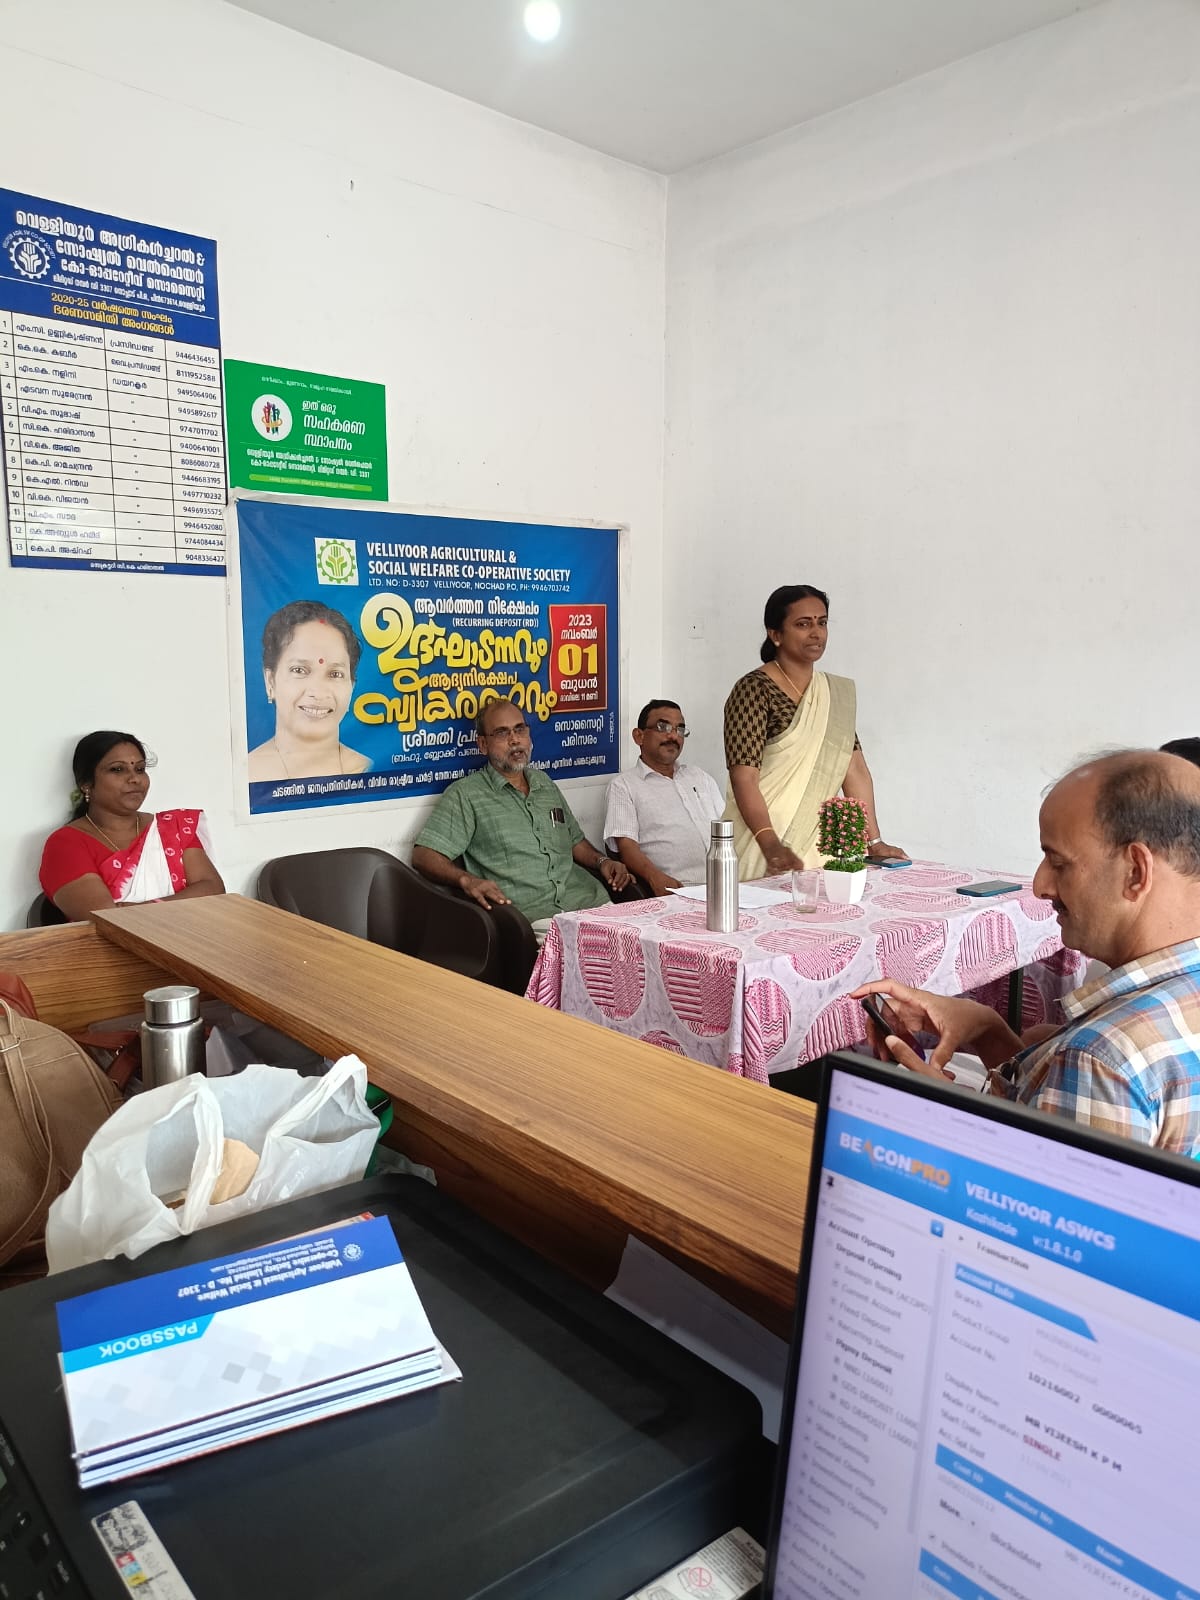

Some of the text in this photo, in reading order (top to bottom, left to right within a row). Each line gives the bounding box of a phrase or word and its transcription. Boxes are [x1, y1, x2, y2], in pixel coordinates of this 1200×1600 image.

[16, 210, 94, 242] വെള്ളിയൂർ
[55, 239, 122, 267] സോഷ്യൽ
[146, 277, 205, 302] സൊസൈറ്റി
[51, 292, 89, 307] 2020-25
[53, 304, 175, 335] ഭരണസമിതി അംഗങ്ങൾ
[3, 320, 7, 328] 1
[175, 351, 215, 364] 9446436455
[3, 340, 8, 348] 2
[178, 407, 217, 418] 9495892617
[321, 403, 336, 415] ഒരു
[303, 414, 366, 435] സഹകരണ
[9, 439, 15, 447] 7
[304, 434, 352, 451] സ്ഥാപനം
[11, 456, 16, 464] 8
[12, 473, 17, 481] 9
[12, 490, 20, 498] 10
[14, 508, 20, 516] 11
[14, 526, 22, 534] 12
[16, 543, 23, 551] 13
[366, 542, 517, 564] VELLIYOOR AGRICULTURAL &
[368, 560, 571, 582] SOCIAL WELFARE CO-OPERATIVE SOCIETY
[369, 578, 383, 586] LTD.
[386, 579, 400, 587] NO:
[402, 579, 429, 588] D-3307
[434, 580, 473, 590] VELLIYOOR,
[475, 582, 505, 590] NOCHAD
[531, 584, 570, 592] 9946703742
[415, 596, 539, 617] ആവർത്തന നിക്ഷേപം
[452, 618, 539, 628] (RECURRING DEPOSIT (RD))
[568, 614, 592, 627] 2023
[360, 592, 548, 674] ഉദ്ഘാടനവും
[560, 627, 598, 640] നവംബർ
[558, 643, 598, 676] 01
[429, 667, 518, 691] ആദ്യനിക്ഷേപ
[560, 676, 598, 693] ബുധൻ
[554, 715, 604, 735] സൊസൈറ്റി
[402, 727, 454, 752] ശ്രീമതി
[561, 732, 598, 747] പരിസരം
[272, 784, 305, 798] ചടങ്ങിൽ
[839, 1132, 951, 1187] BEACONPRO
[965, 1180, 1116, 1251] VELLIYOOR ASWCS
[828, 1220, 895, 1258] Account Opening
[836, 1243, 902, 1281] Deposit Opening
[976, 1241, 1029, 1271] Transaction
[197, 1287, 228, 1302] Welfare
[98, 1321, 198, 1359] PASSBOOK
